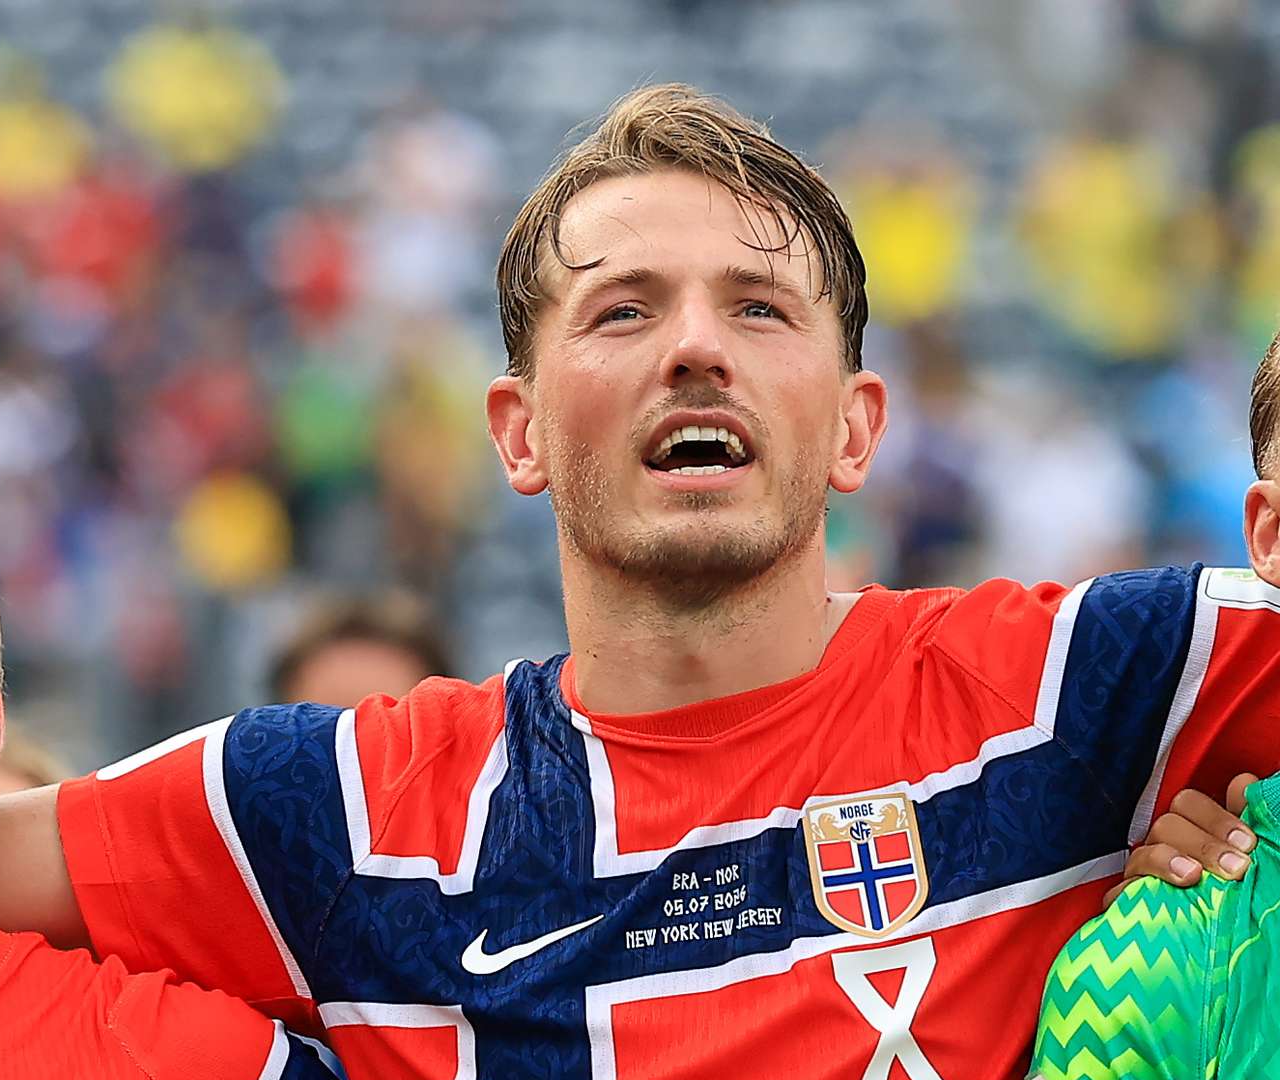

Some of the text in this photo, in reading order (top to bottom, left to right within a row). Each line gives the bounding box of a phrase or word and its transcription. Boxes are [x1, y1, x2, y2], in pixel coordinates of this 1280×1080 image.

[839, 803, 874, 820] NORGE
[672, 871, 700, 890] BRA
[715, 864, 740, 886] NOR
[625, 907, 782, 949] NEW YORK NEW JERSEY
